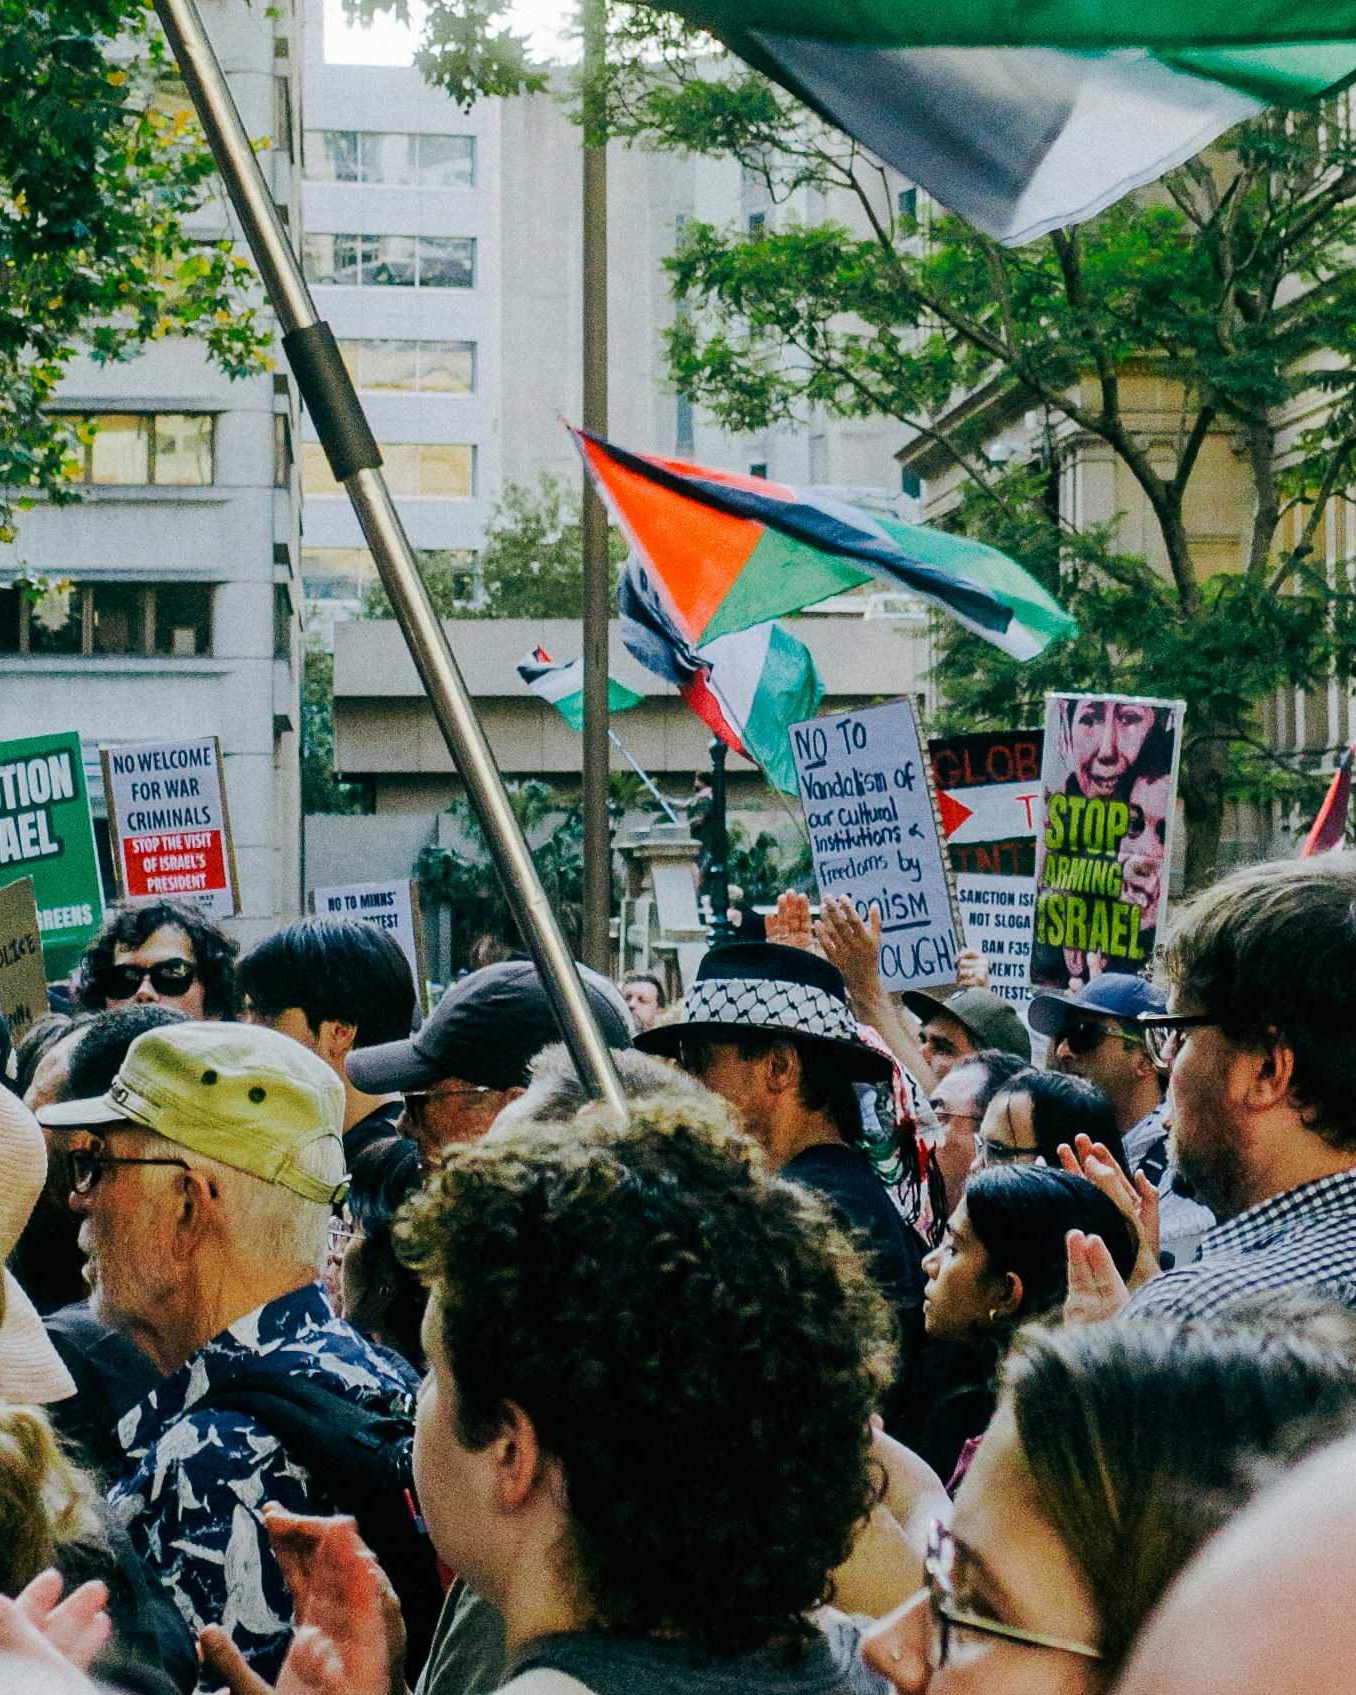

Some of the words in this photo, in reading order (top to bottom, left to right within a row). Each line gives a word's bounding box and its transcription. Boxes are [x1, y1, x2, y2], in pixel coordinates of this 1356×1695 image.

[794, 727, 828, 762] NO
[836, 718, 867, 754] TO
[113, 754, 135, 774] NO
[138, 747, 211, 772] WELCOME
[932, 742, 1039, 786] GLOB
[131, 781, 161, 802] FOR
[164, 777, 200, 799] WAR
[801, 767, 888, 800] Vandalism
[894, 760, 916, 792] of
[127, 805, 211, 831] CRIMINALS
[808, 808, 834, 828] our
[1045, 793, 1129, 856] STOP
[132, 836, 160, 853] STOP
[162, 834, 183, 852] THE
[184, 832, 212, 849] VISIT
[143, 857, 158, 873] OF
[160, 854, 206, 871] ISRAEL'S
[819, 855, 888, 886] freedoms
[897, 850, 922, 882] by
[1043, 855, 1122, 897] ARMING
[146, 873, 206, 893] PRESIDENT
[328, 897, 341, 912] NO
[344, 894, 357, 910] TO
[959, 889, 1015, 906] SANCTION
[1019, 893, 1034, 906] IS
[38, 904, 93, 930] REENS
[969, 912, 990, 926] NOT
[995, 914, 1030, 929] SLOGA
[1037, 893, 1145, 960] ISRAEL
[881, 928, 957, 980] OUGH!
[982, 940, 1004, 954] BAN
[988, 962, 1024, 978] MENTS
[991, 985, 1032, 1001] OTESTS
